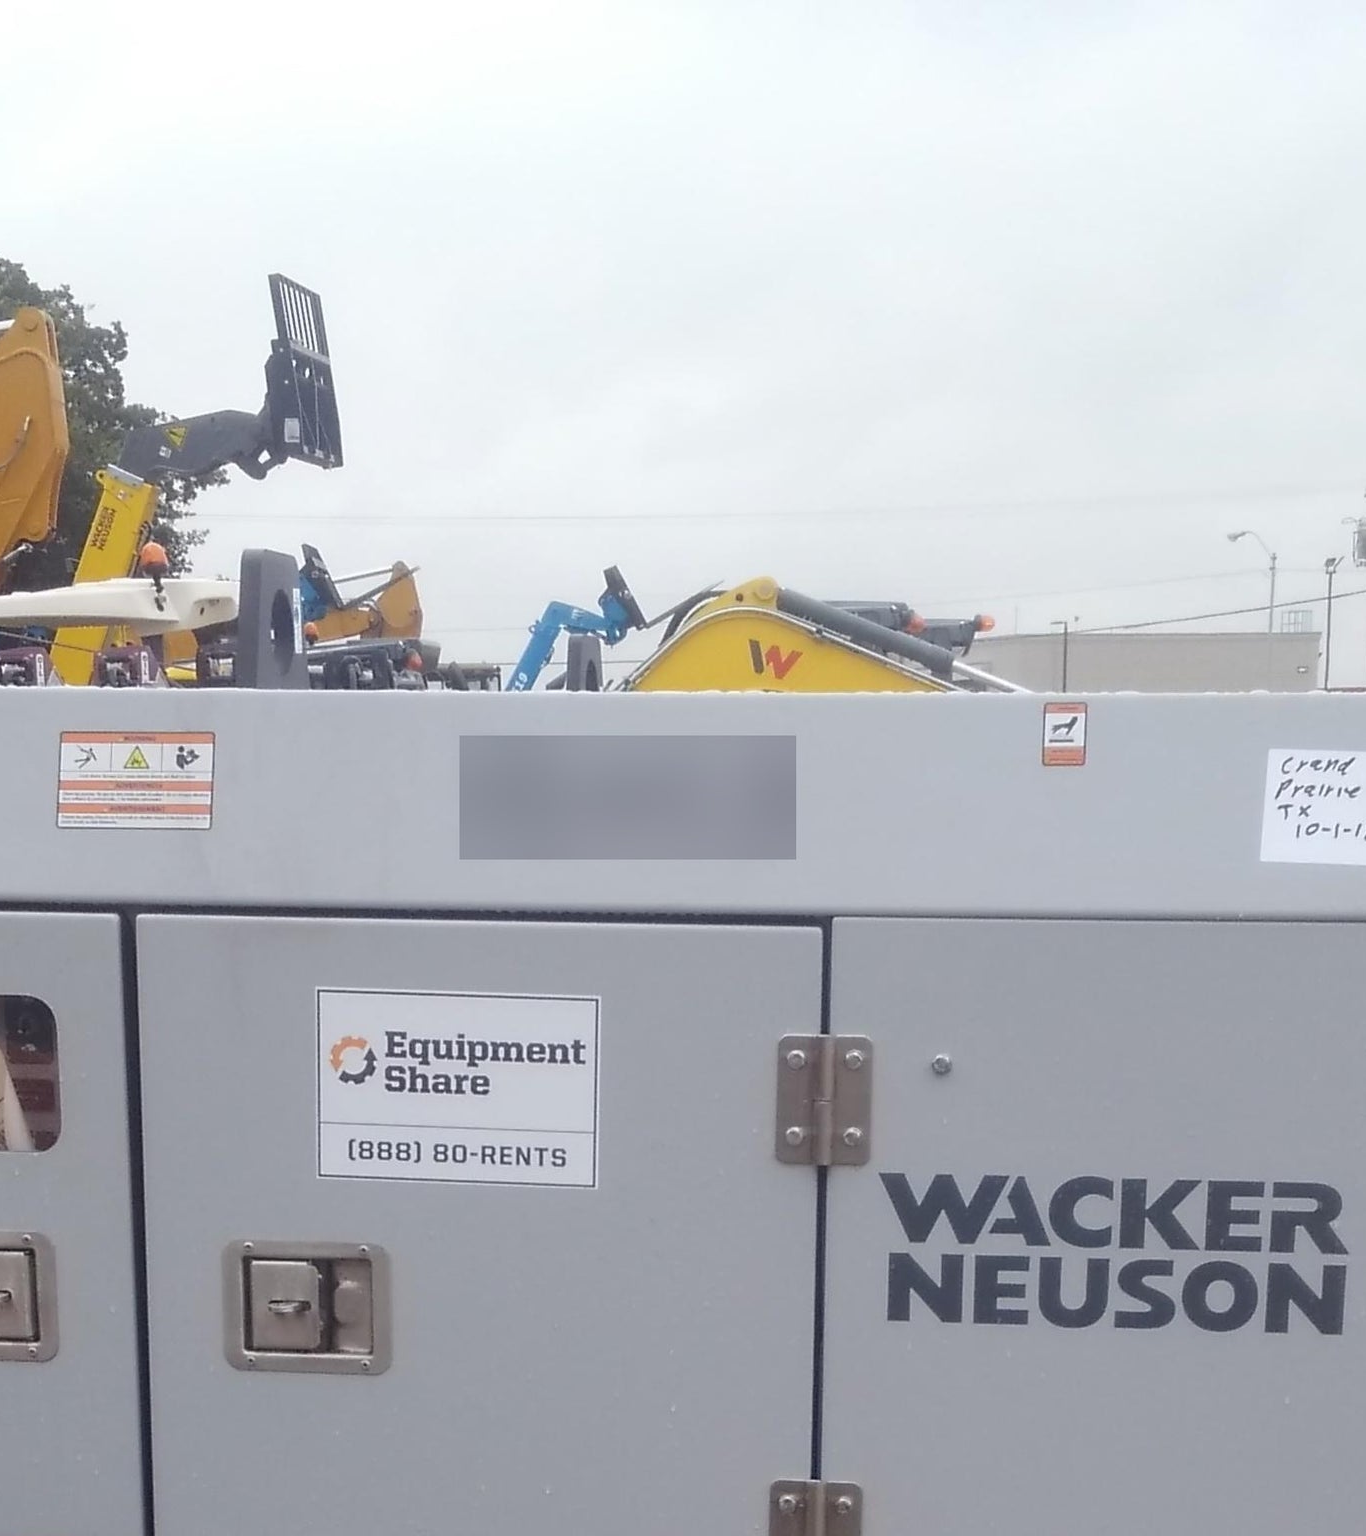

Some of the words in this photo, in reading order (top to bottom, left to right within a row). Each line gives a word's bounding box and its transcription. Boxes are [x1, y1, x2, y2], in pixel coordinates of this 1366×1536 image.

[1275, 778, 1361, 800] Prairie
[1277, 804, 1312, 820] TX
[384, 1031, 586, 1067] Equipment
[384, 1066, 490, 1095] Share
[348, 1139, 422, 1163] (888)
[433, 1143, 567, 1167] 80-RENTS
[878, 1172, 1350, 1255] WACKER
[886, 1252, 1347, 1335] NEUSON
